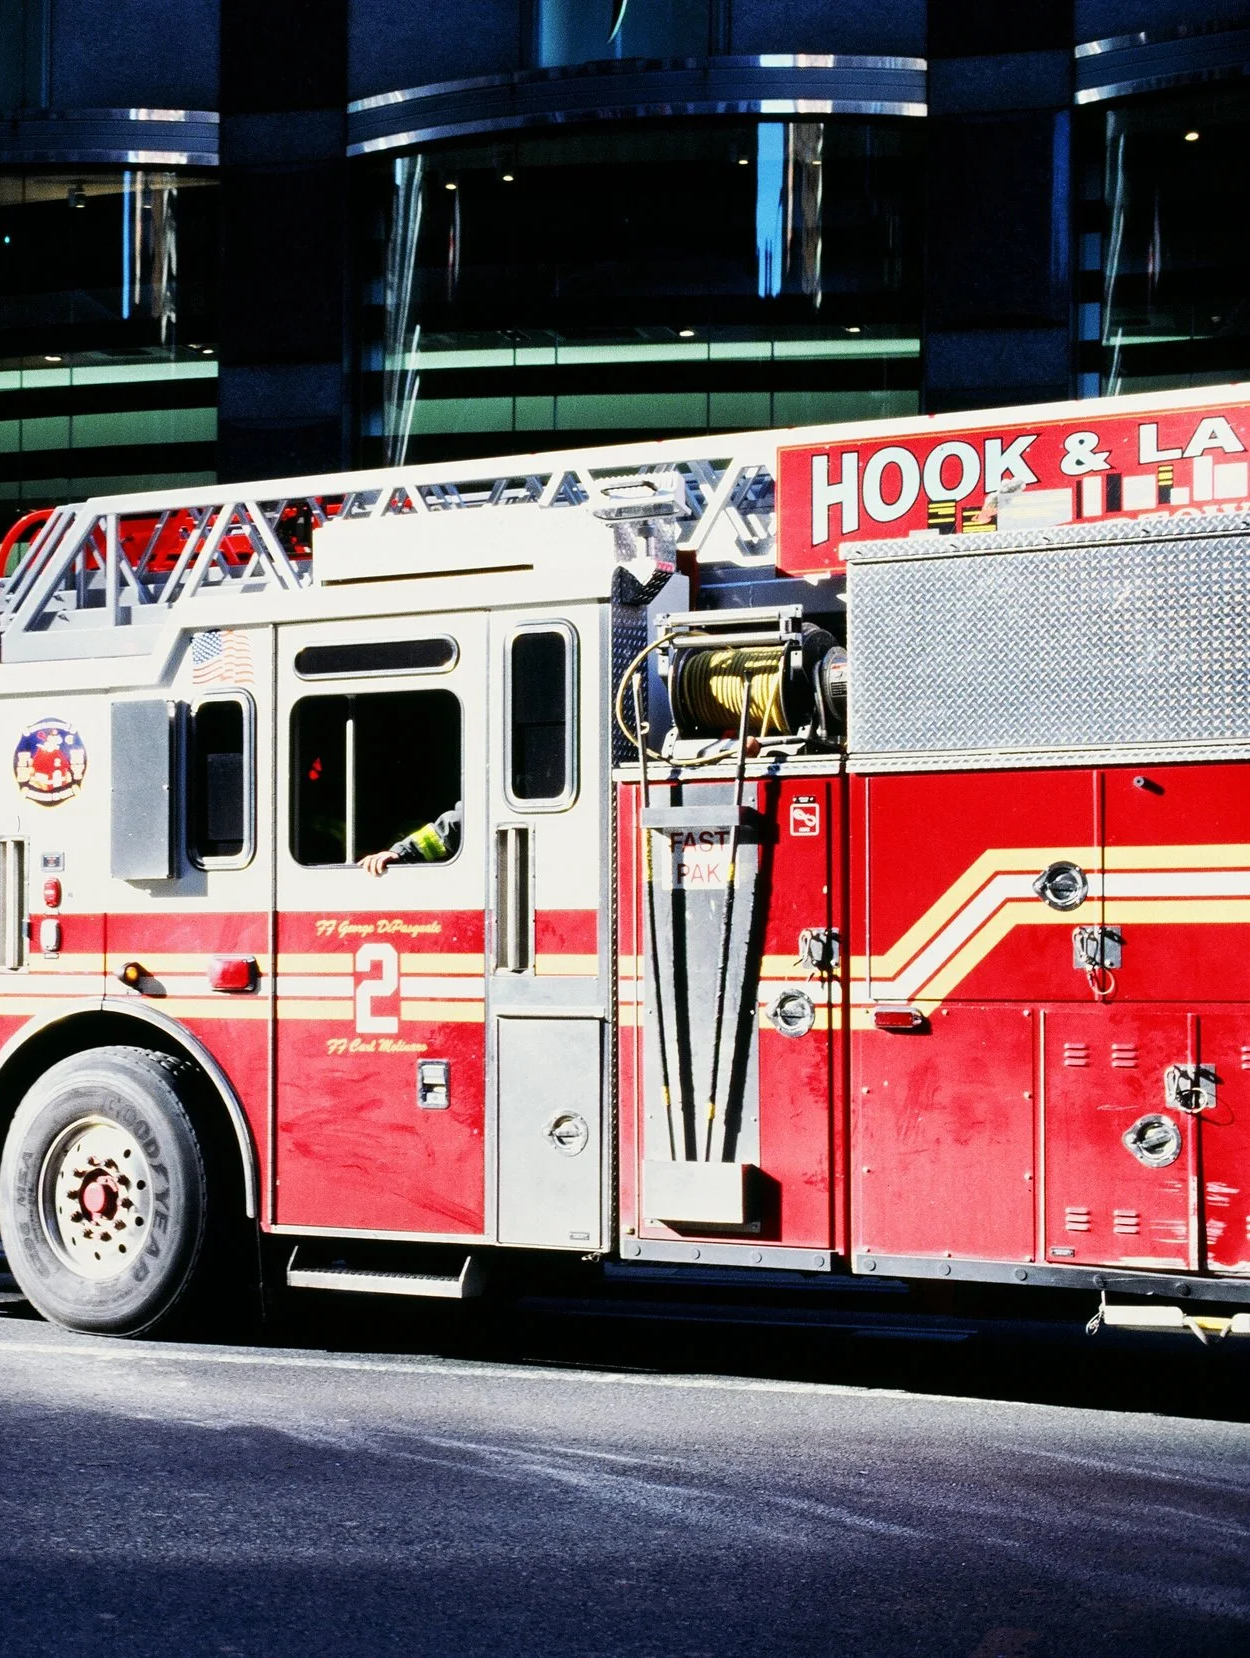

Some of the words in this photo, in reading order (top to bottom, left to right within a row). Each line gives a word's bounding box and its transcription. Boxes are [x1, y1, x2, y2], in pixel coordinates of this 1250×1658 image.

[811, 432, 1041, 548] HOOK
[1060, 431, 1112, 477] &
[1138, 415, 1247, 465] LA
[670, 830, 731, 854] FAST
[676, 862, 722, 884] PAK
[338, 919, 375, 939] George
[377, 919, 441, 937] DiPasquale
[355, 943, 399, 1033] 2
[349, 1037, 376, 1053] Carl
[101, 1096, 171, 1282] GOODYEAR
